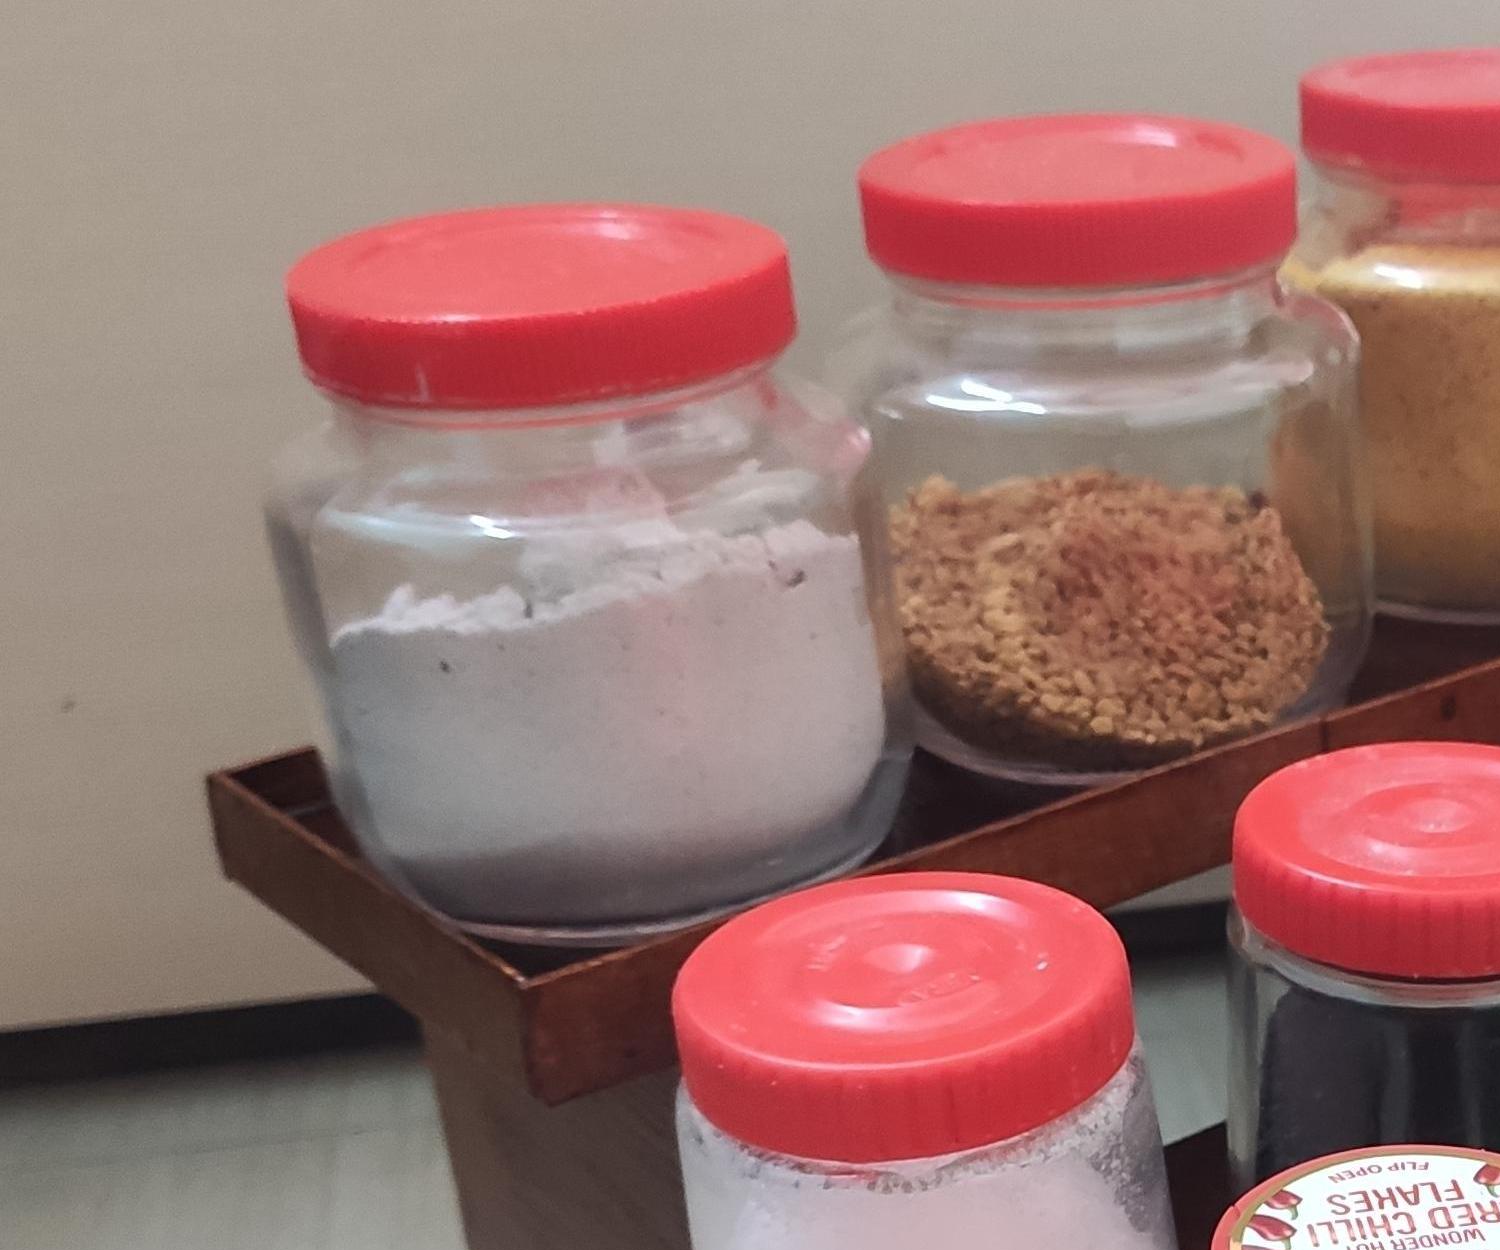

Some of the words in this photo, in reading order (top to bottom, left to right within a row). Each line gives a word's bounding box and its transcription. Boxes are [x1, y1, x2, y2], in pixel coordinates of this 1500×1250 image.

[1328, 1164, 1383, 1184] OPEN
[1384, 1161, 1430, 1176] FLIP
[1326, 1178, 1466, 1216] FLAKES
[1306, 1210, 1420, 1248] CHILLI
